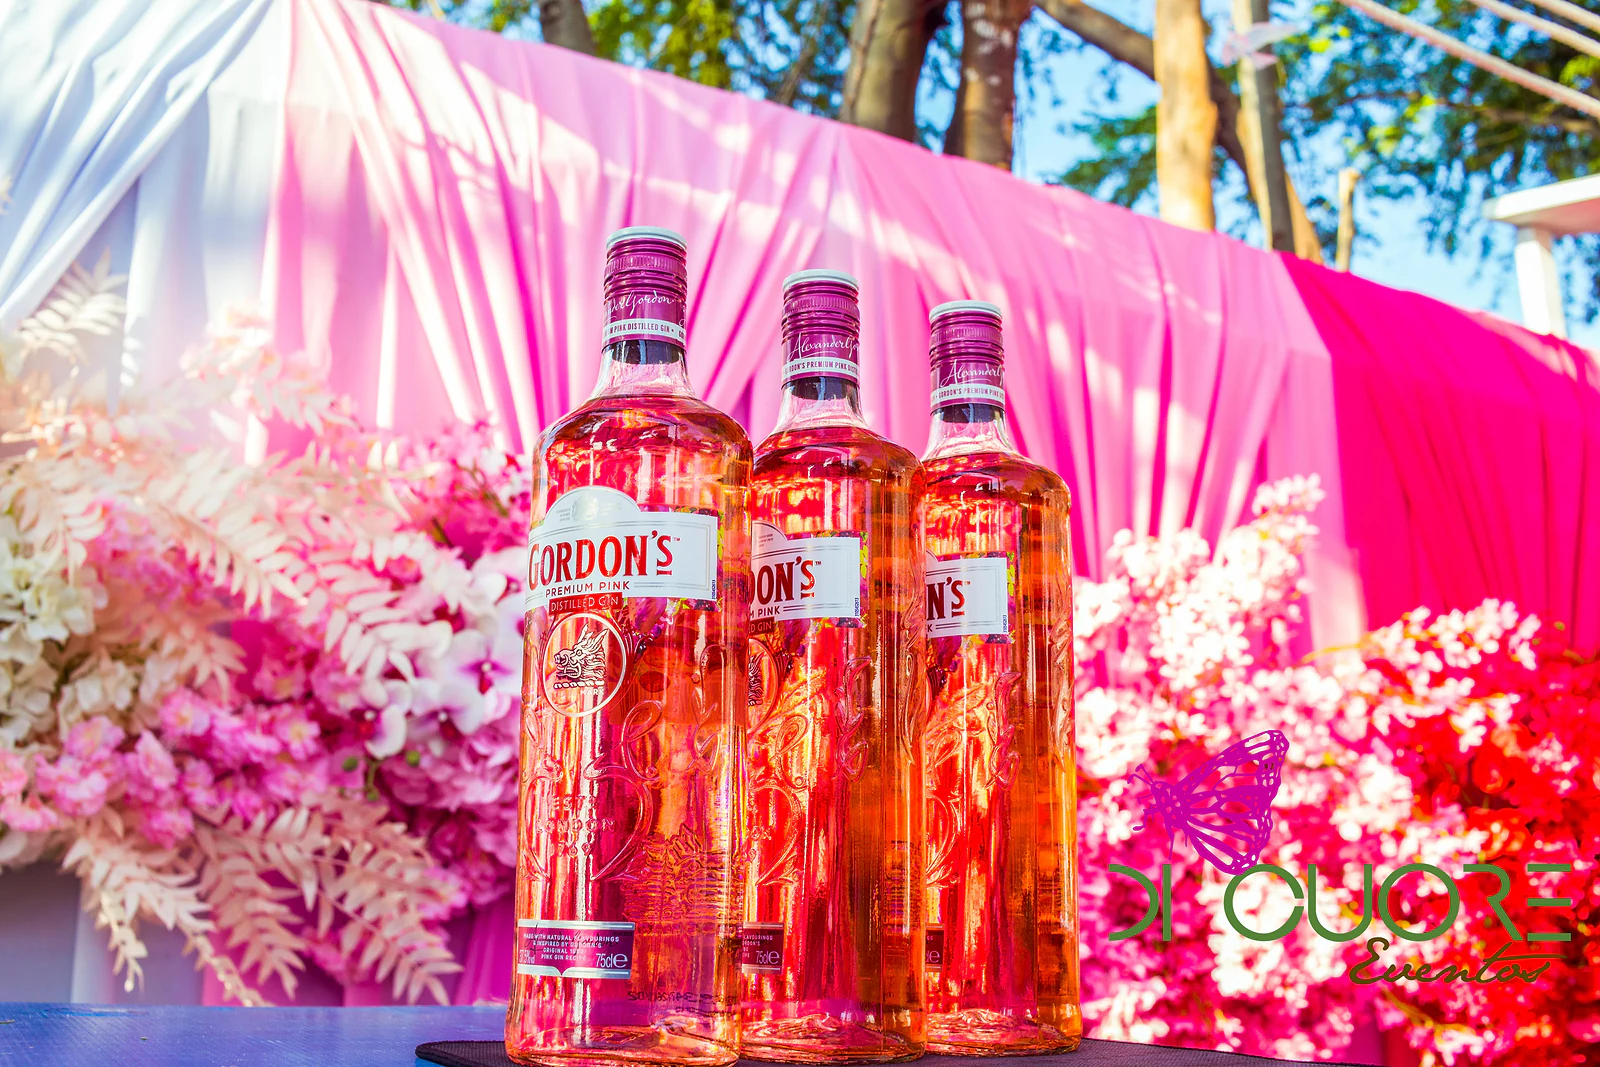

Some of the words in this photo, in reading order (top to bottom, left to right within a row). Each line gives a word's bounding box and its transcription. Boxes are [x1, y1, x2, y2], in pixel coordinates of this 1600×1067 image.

[614, 323, 627, 333] PINK
[627, 322, 659, 331] DISTILLED
[660, 324, 670, 333] GIN
[806, 361, 834, 369] PREMIUM
[834, 362, 847, 370] PINK
[963, 387, 988, 395] PREMIUM
[528, 530, 673, 591] GORDON'S
[545, 582, 594, 599] PREMIUM
[599, 580, 631, 592] PINK
[550, 598, 595, 612] DISTILLED
[598, 596, 619, 607] GIN
[757, 605, 781, 618] PINK
[757, 620, 772, 632] GIN
